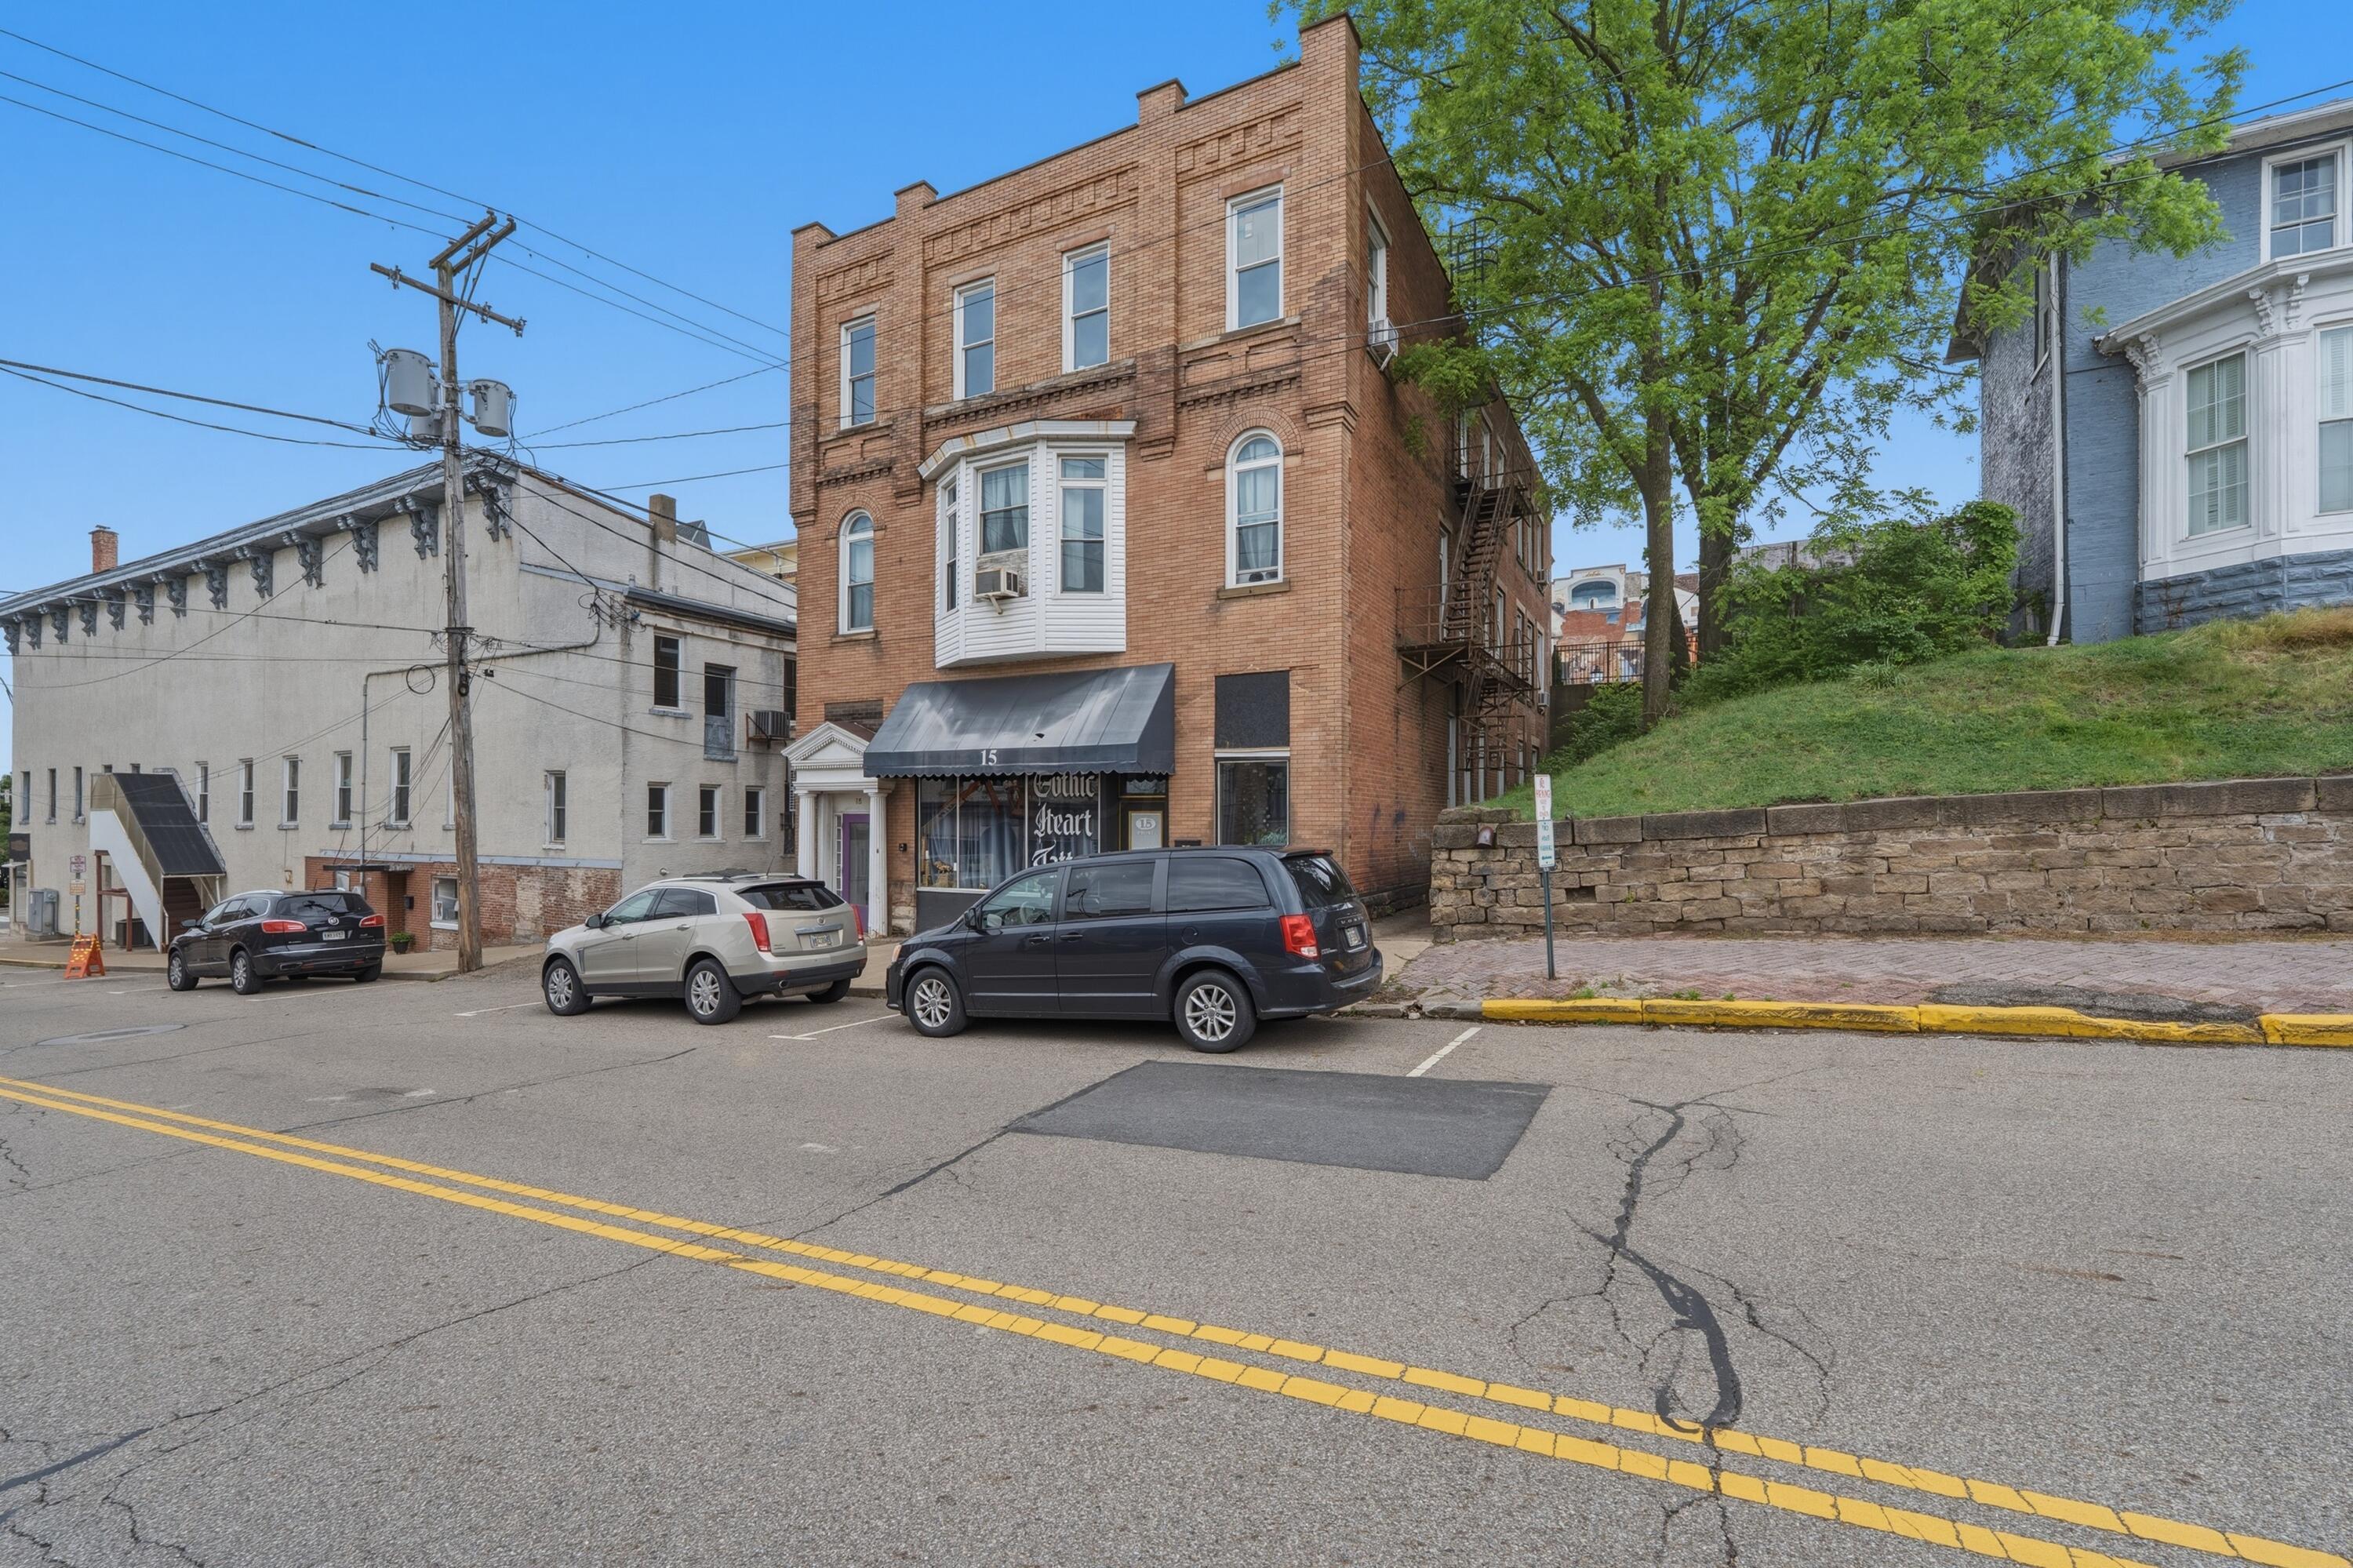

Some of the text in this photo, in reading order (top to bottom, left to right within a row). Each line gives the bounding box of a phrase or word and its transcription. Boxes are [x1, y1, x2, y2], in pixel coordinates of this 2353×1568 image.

[980, 750, 997, 766] 15
[1034, 802, 1093, 838] Heart
[1140, 819, 1152, 828] 15
